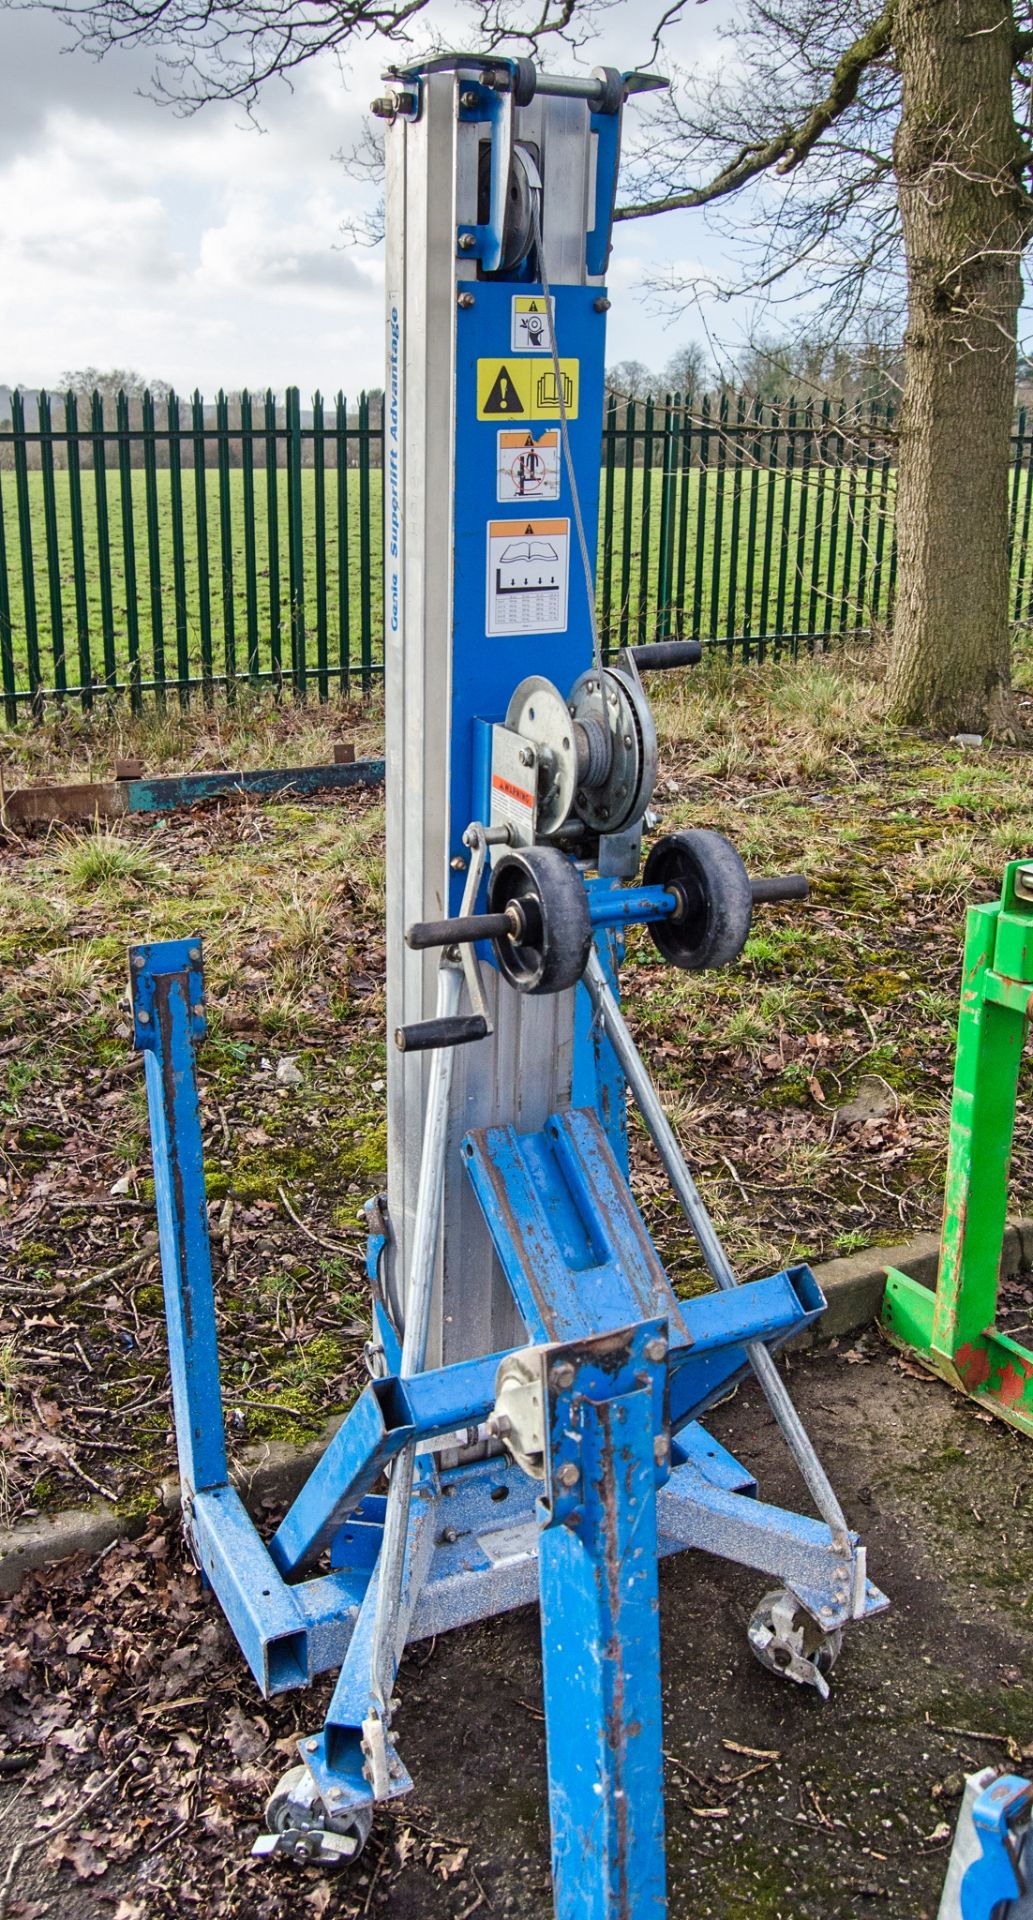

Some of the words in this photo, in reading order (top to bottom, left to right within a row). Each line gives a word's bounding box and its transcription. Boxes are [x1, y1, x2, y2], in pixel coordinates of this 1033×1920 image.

[390, 307, 399, 441] Advantage
[390, 450, 399, 557] Superlift
[390, 574, 398, 631] Genie
[504, 783, 529, 804] WARNING
